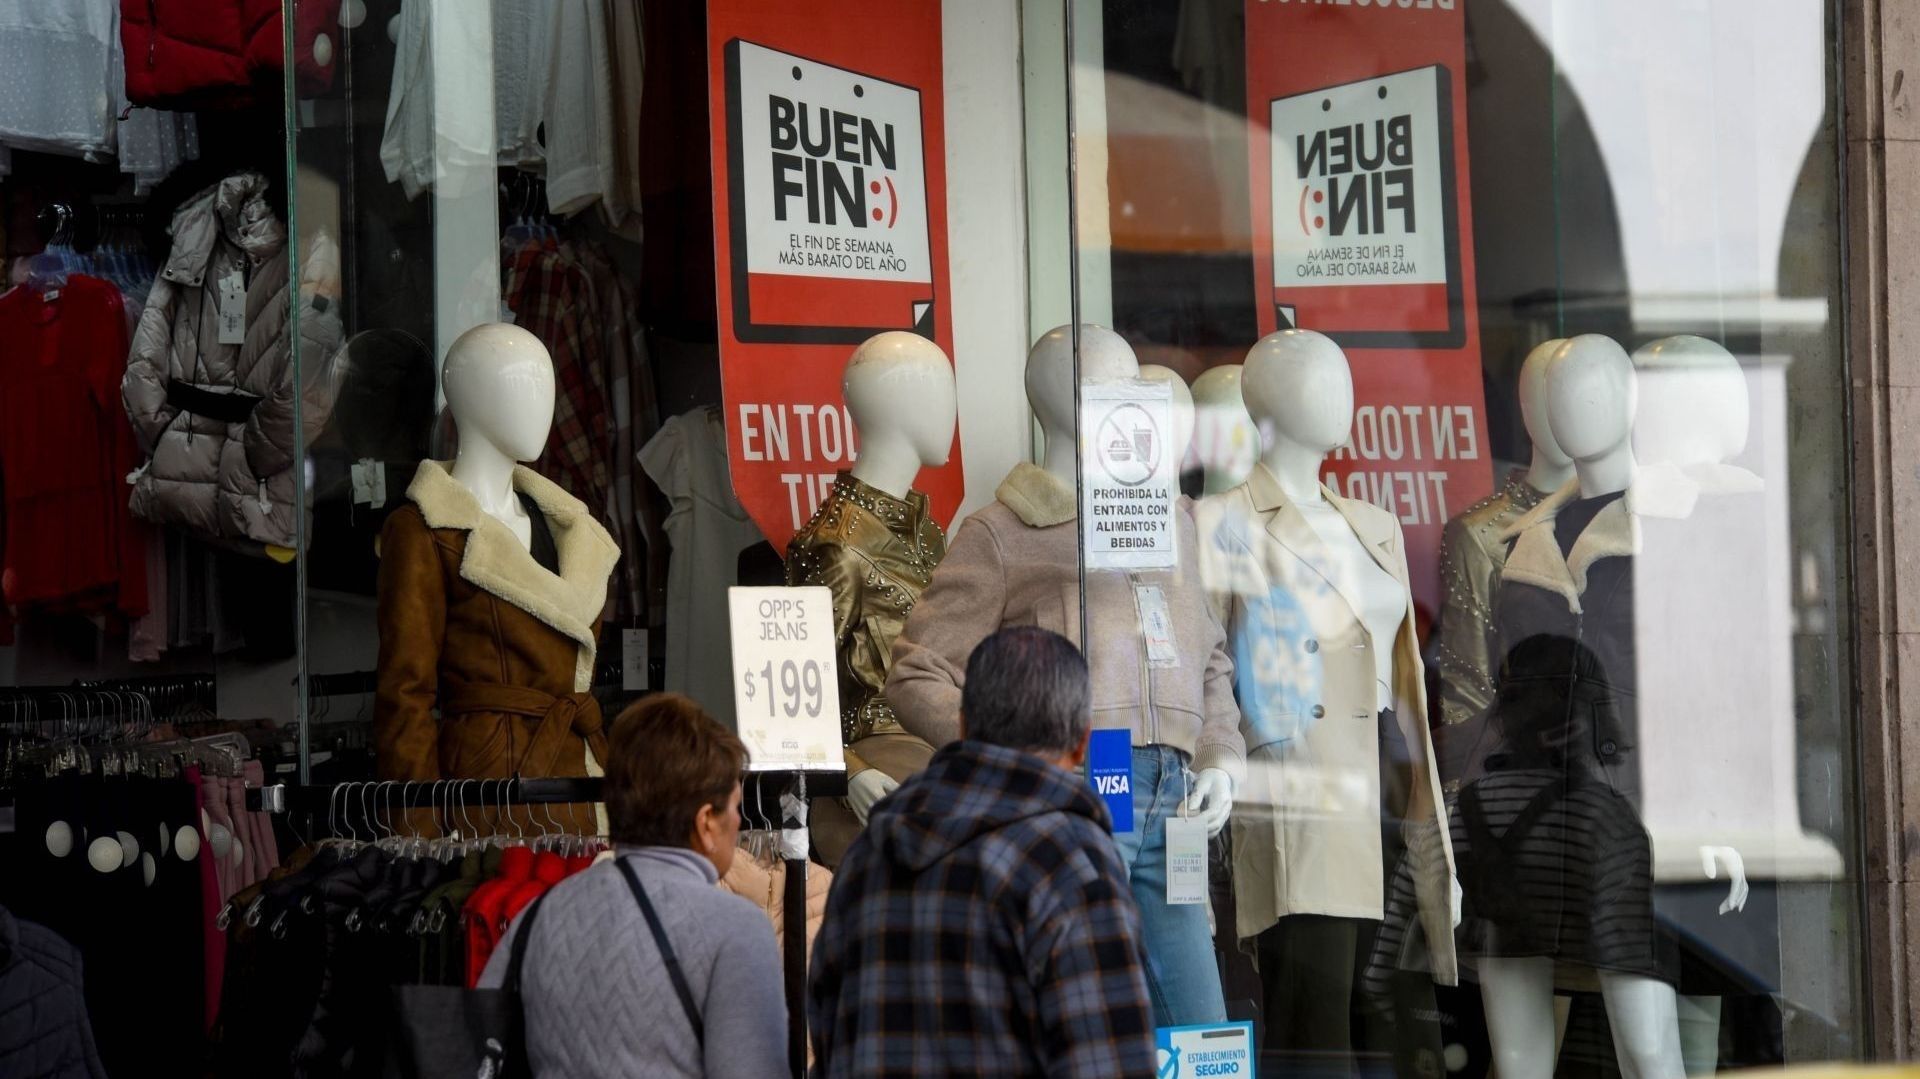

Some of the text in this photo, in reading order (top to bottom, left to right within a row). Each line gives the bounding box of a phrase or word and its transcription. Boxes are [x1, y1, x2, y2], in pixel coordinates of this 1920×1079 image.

[769, 94, 896, 170] BUEN
[790, 233, 894, 255] EL FIN DE SEMANA
[779, 249, 907, 272] MÁS BARATO DEL AÑO
[739, 404, 857, 463] EN TO
[1093, 489, 1168, 500] PROHIBIDA LA
[1093, 505, 1168, 516] ENTRADA CON
[1096, 521, 1167, 532] ALIMENTOS Y
[1110, 538, 1155, 549] BEBIDAS
[758, 600, 805, 619] OPP'S
[760, 622, 808, 641] JEANS
[1093, 775, 1130, 794] VISA
[1188, 1049, 1246, 1063] ESTABLECIMIENTO
[1195, 1062, 1239, 1077] SEGURO
